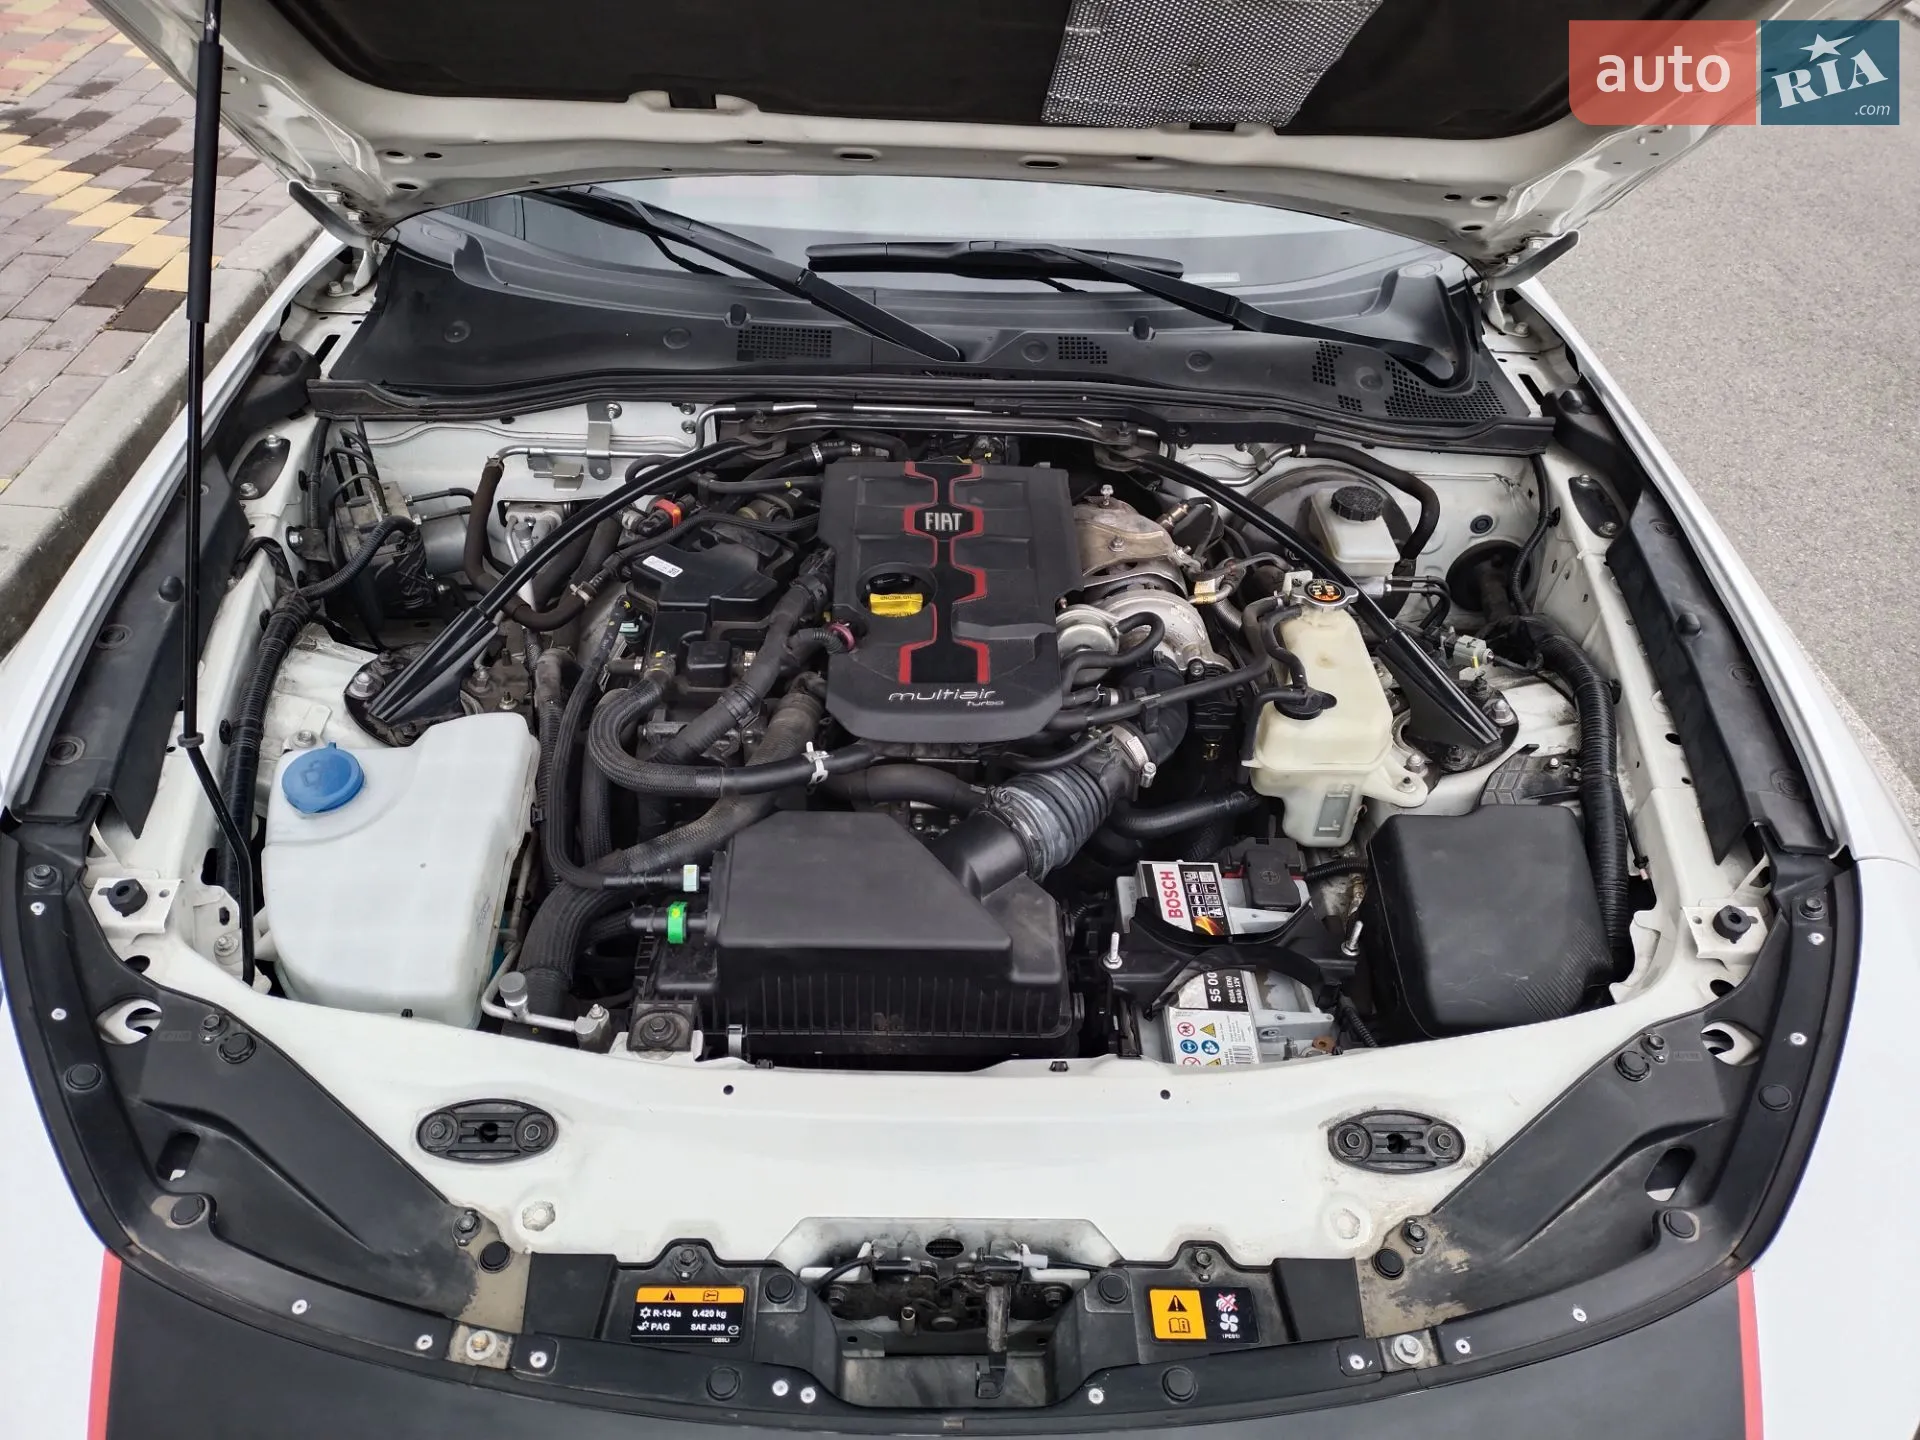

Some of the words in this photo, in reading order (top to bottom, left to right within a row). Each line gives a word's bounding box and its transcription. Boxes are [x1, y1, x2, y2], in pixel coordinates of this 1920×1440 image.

[925, 511, 963, 531] FIAT
[888, 688, 996, 701] multiair
[1160, 871, 1184, 918] BOSCH
[1208, 988, 1222, 1002] S5
[652, 1309, 681, 1318] R-134a
[692, 1309, 714, 1318] 0.420
[716, 1309, 727, 1319] kg
[650, 1322, 670, 1331] PAG
[691, 1323, 706, 1331] SAE
[708, 1323, 726, 1331] J639
